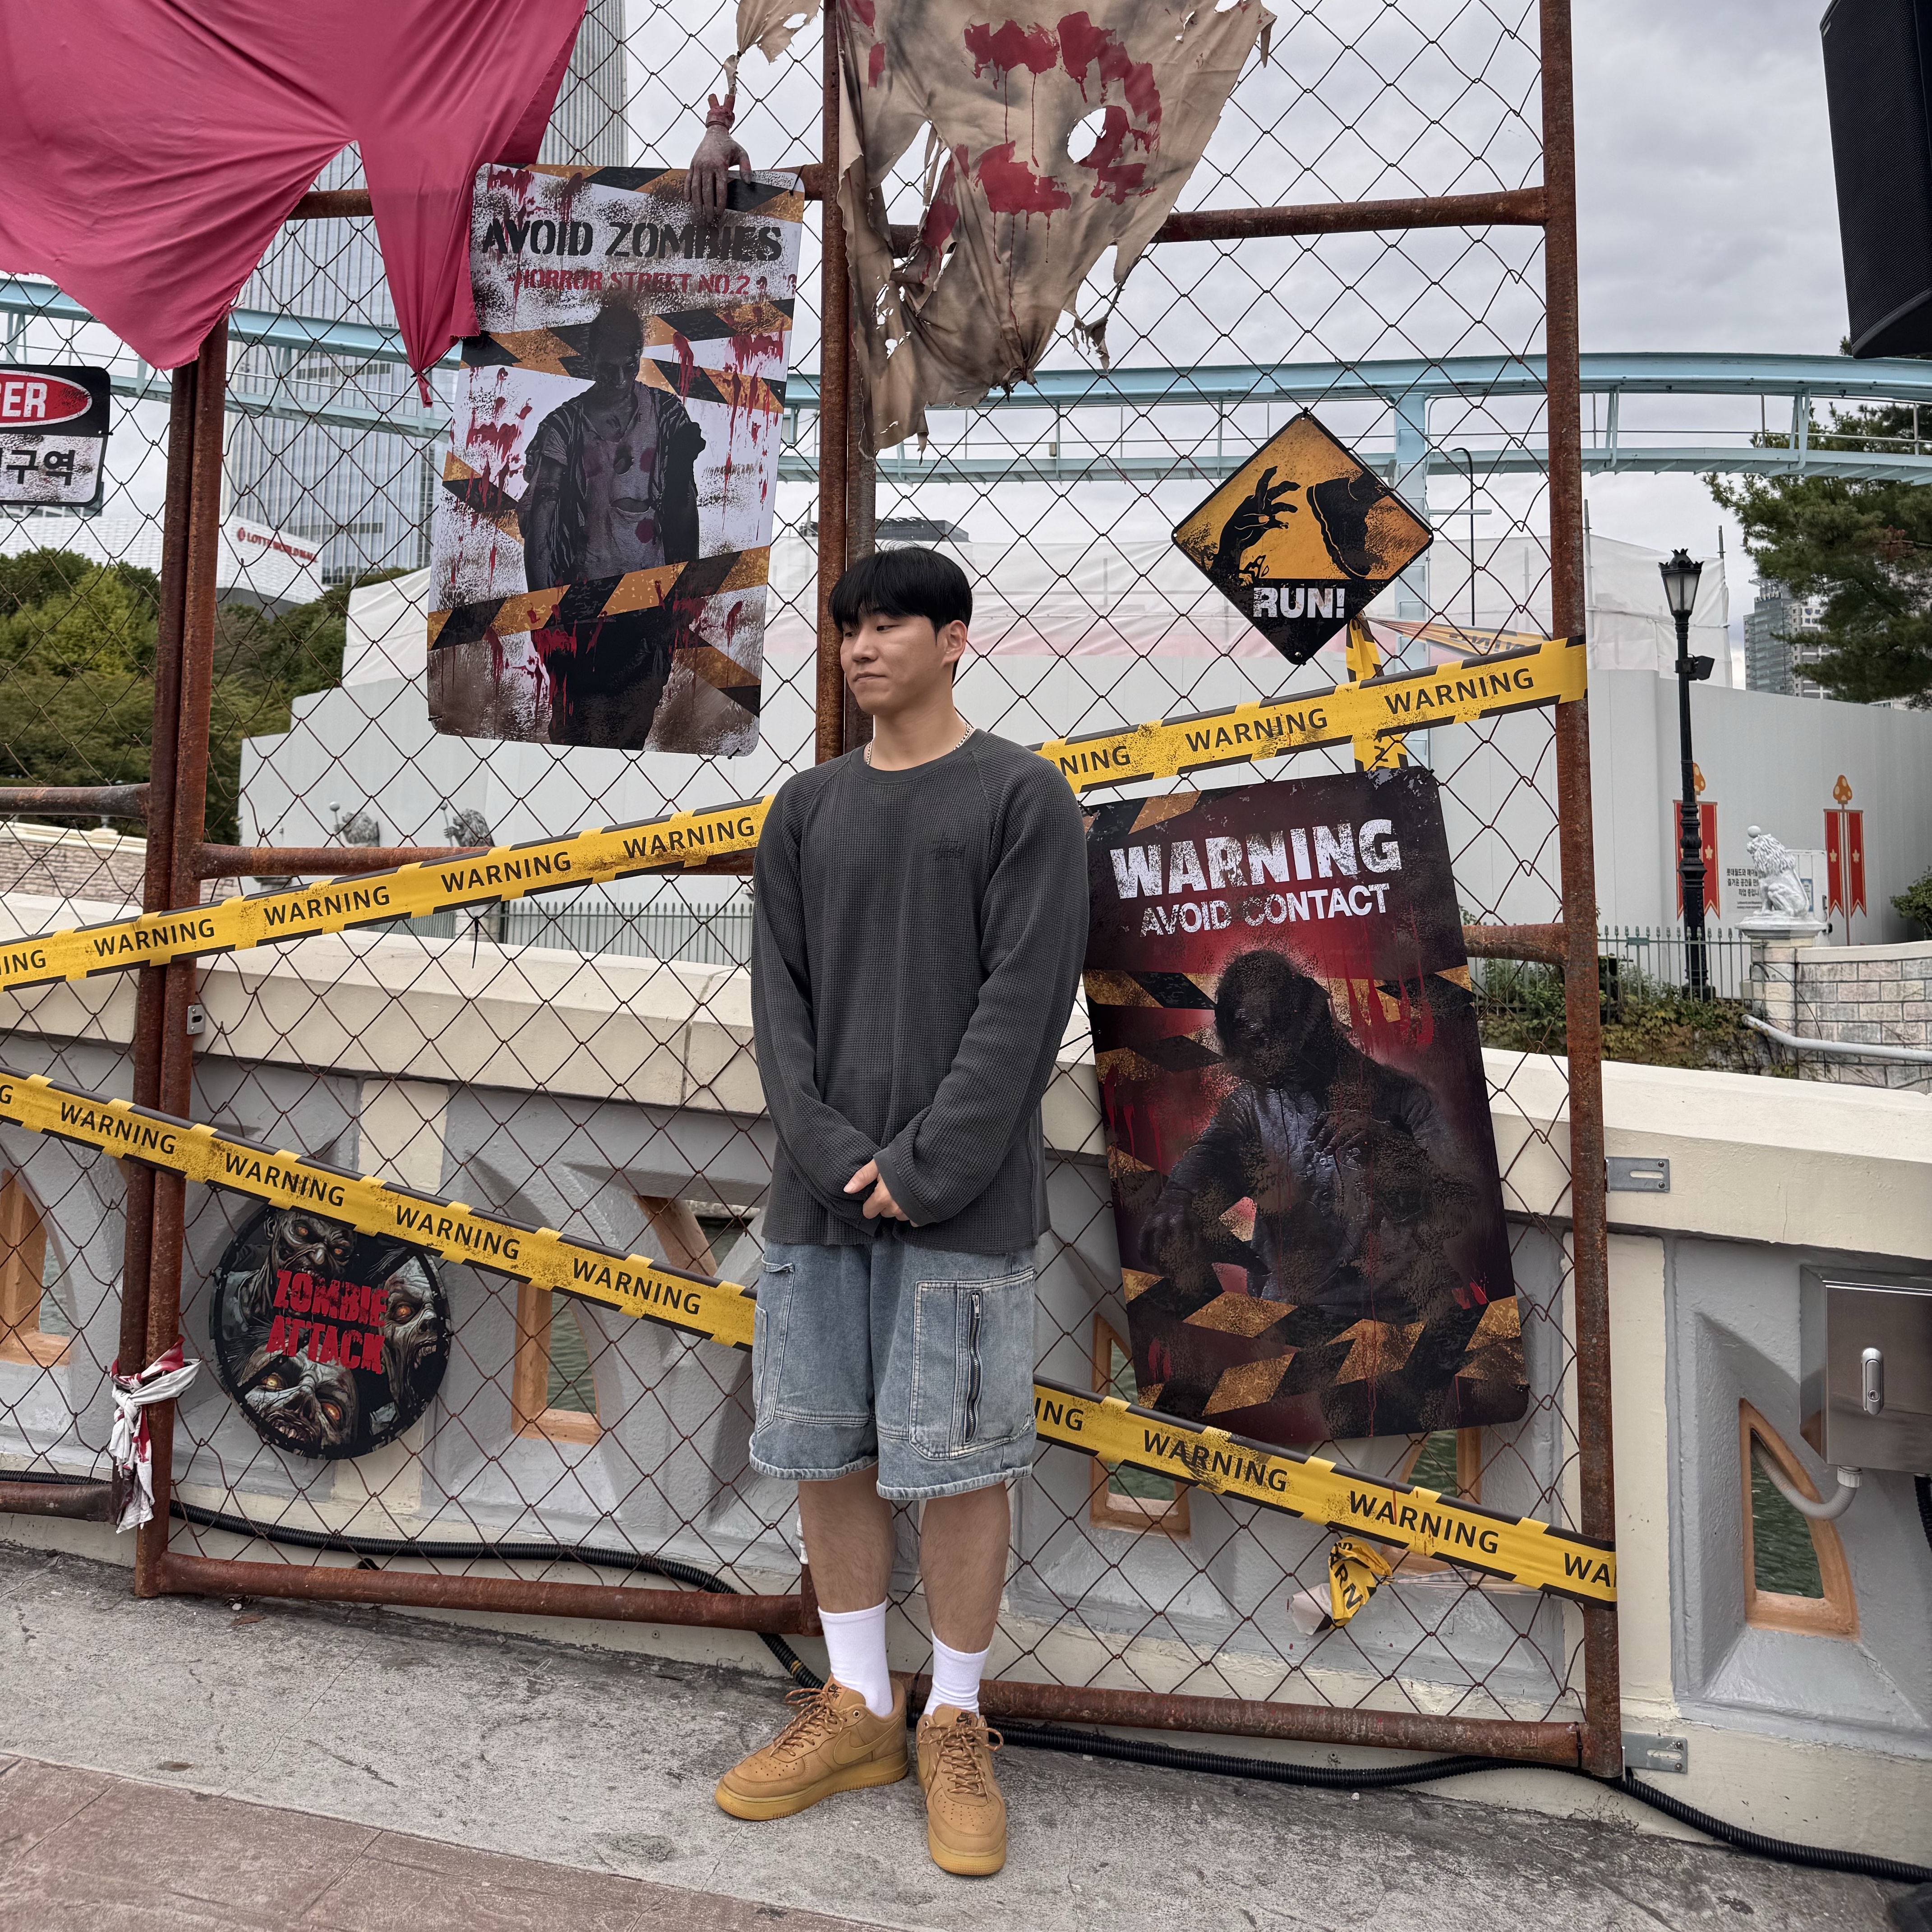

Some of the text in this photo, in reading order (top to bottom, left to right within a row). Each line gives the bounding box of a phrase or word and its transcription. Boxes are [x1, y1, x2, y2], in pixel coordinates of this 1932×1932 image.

[482, 218, 782, 261] AVOID ZOMBIES
[515, 270, 750, 295] HORROR STREET NO.2
[0, 382, 47, 418] ER
[0, 448, 75, 486] 구역
[1253, 587, 1345, 618] RUN!
[1049, 668, 1534, 776] NING WARNING WARNING
[1110, 819, 1402, 899] WARNING
[0, 817, 754, 975] ING WARNING WARNING WARNING WARNING
[1140, 883, 1390, 937] AVOID CONTACT
[61, 1102, 176, 1155] WARNING
[226, 1153, 345, 1207] WARNING
[396, 1204, 520, 1260] WARNING
[573, 1257, 701, 1315] WARNING
[273, 1269, 389, 1327] ZOMBIE
[265, 1315, 385, 1375] ATTACK
[1144, 1429, 1288, 1492] WARNING
[1350, 1490, 1499, 1554] WARNING
[1564, 1552, 1616, 1587] WA
